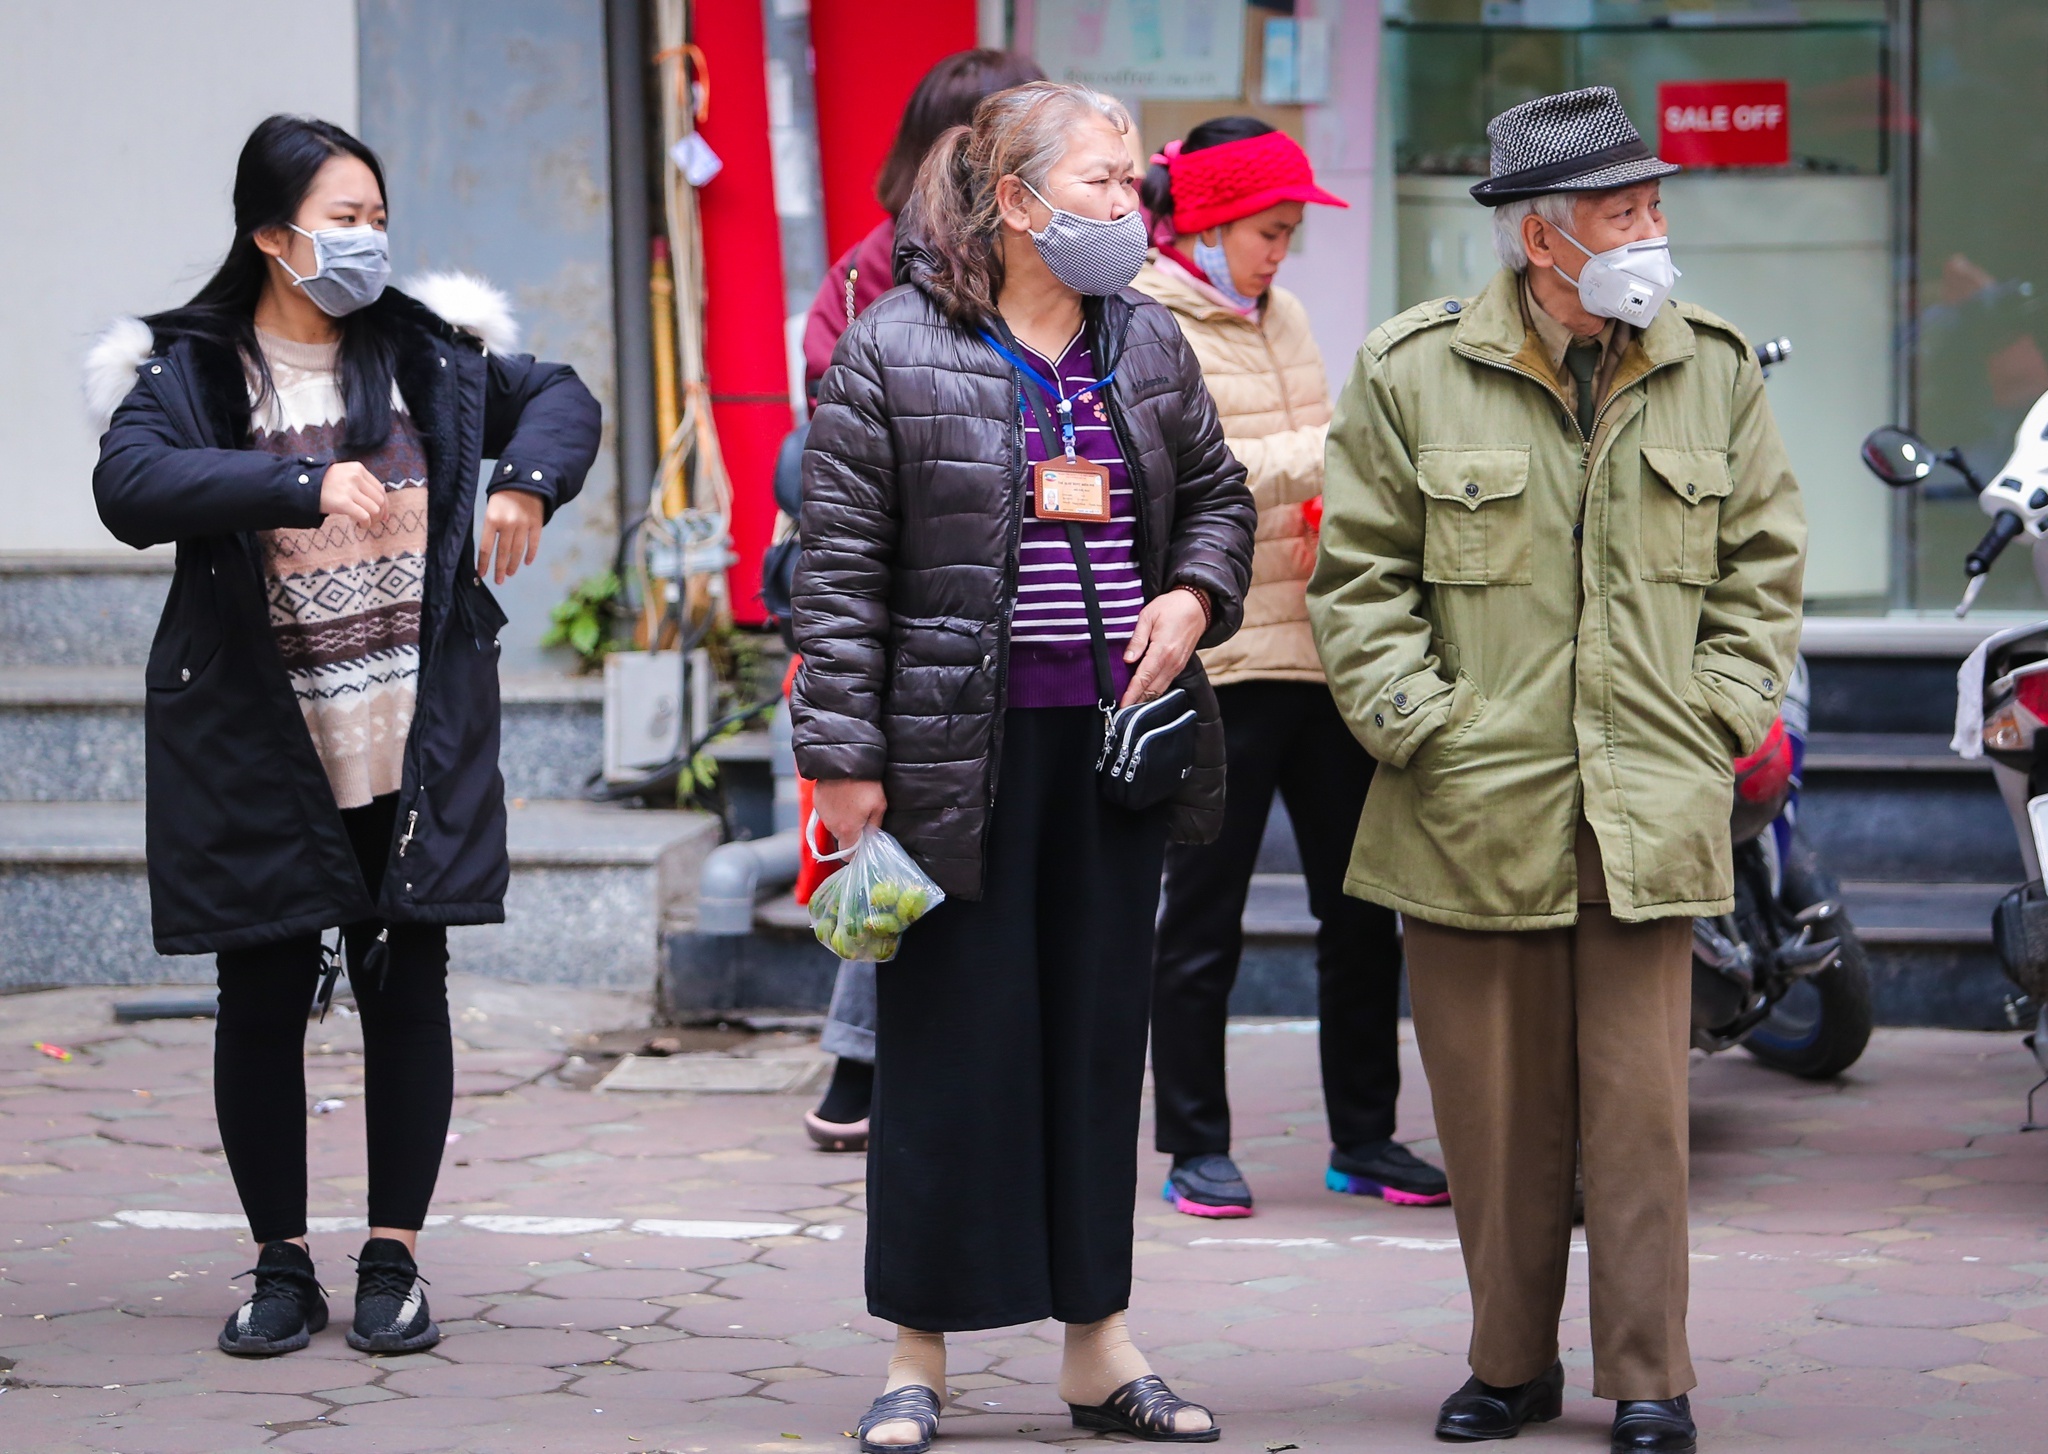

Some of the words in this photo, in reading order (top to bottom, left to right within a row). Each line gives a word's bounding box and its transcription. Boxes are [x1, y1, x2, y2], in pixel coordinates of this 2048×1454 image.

[1665, 105, 1729, 132] SALE
[1732, 104, 1782, 132] OFF
[1631, 297, 1643, 306] 3M
